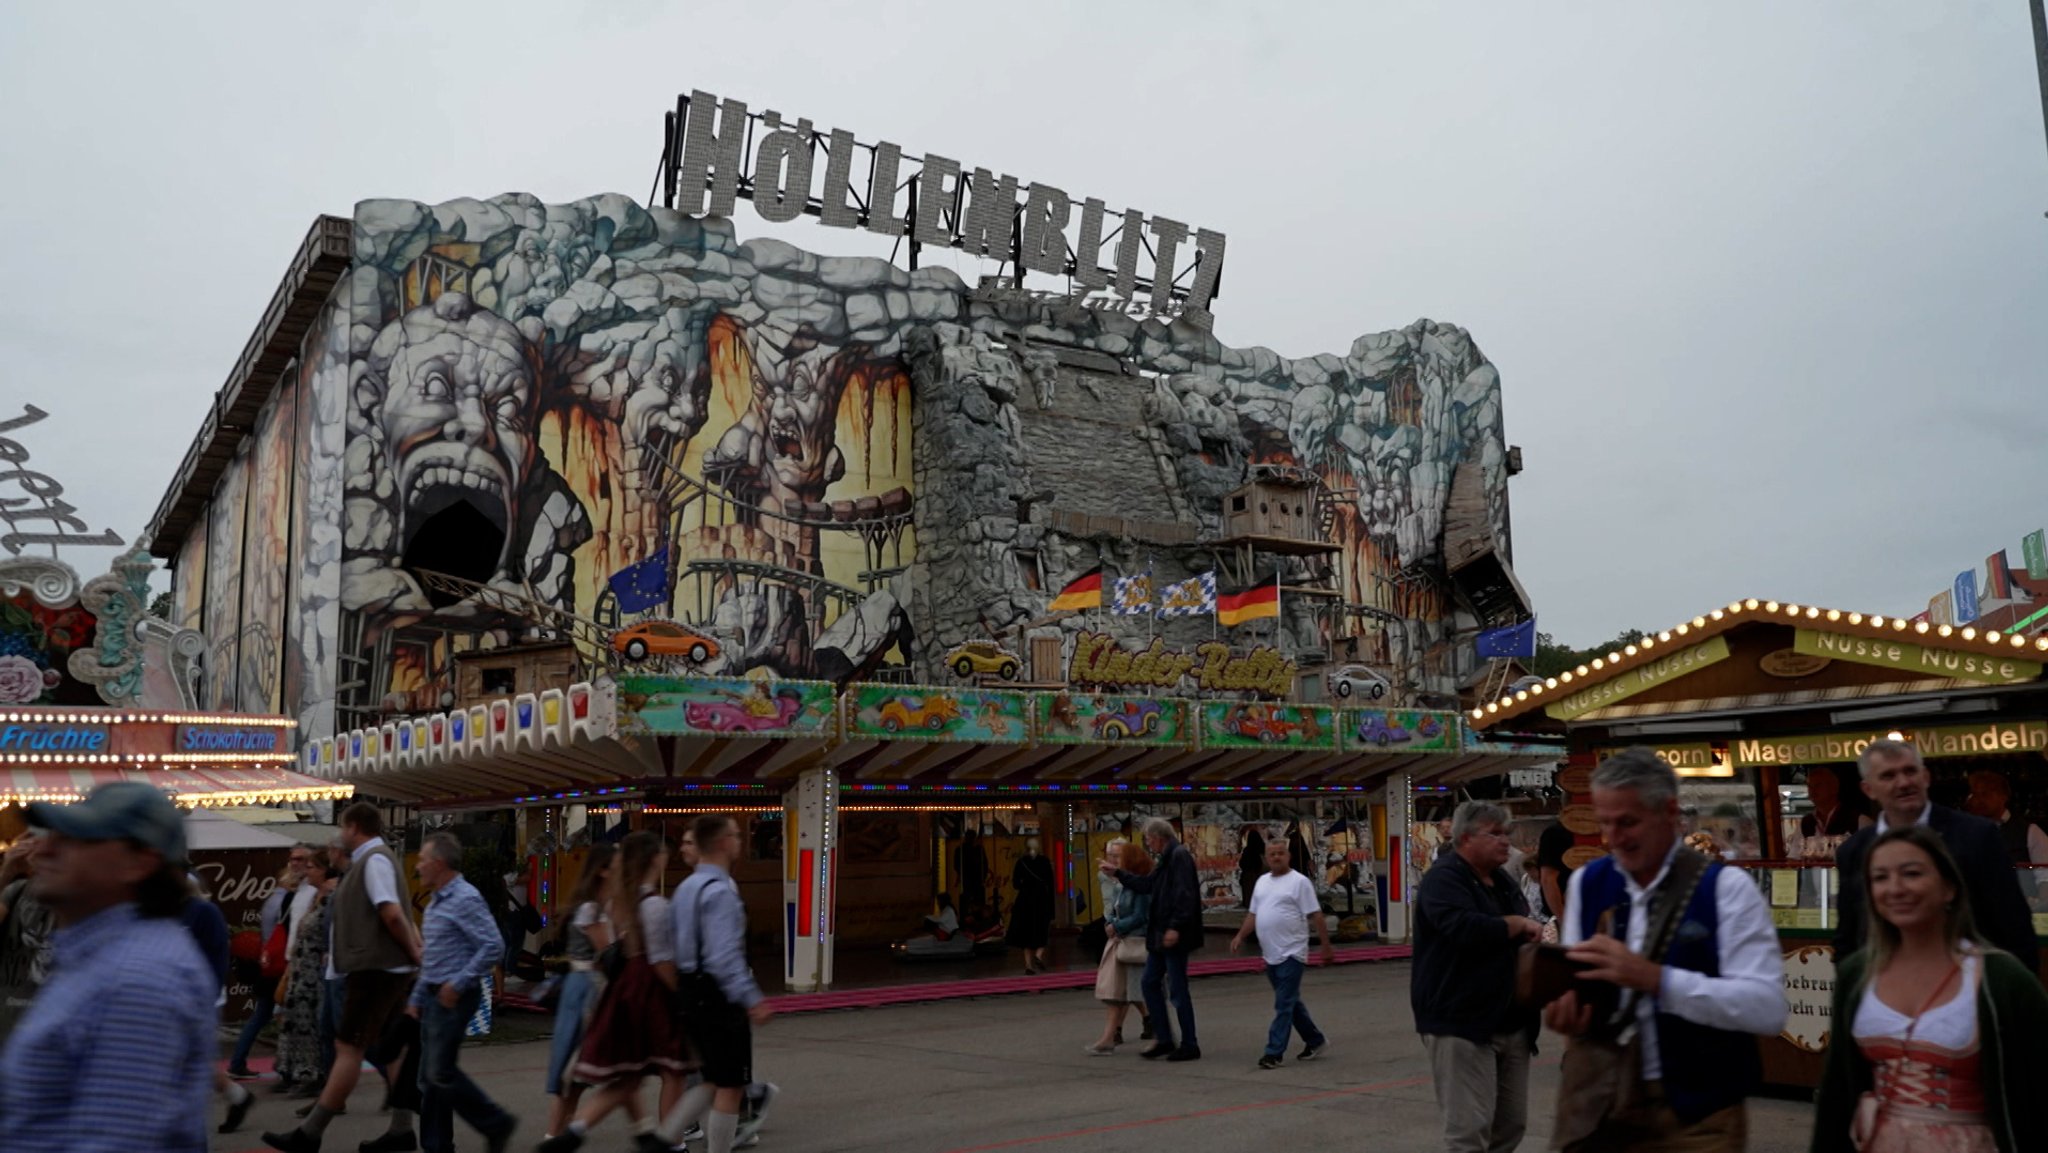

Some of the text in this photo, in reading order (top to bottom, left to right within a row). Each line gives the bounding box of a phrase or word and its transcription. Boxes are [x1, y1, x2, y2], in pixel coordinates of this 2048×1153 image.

[677, 88, 1227, 318] HÖLLENBLITZ
[1817, 630, 1902, 663] Nüsse
[1921, 645, 2017, 679] Nüsse
[0, 725, 106, 752] Früchte
[1914, 722, 2048, 753] Mandeln
[1508, 769, 1553, 788] TICKETS
